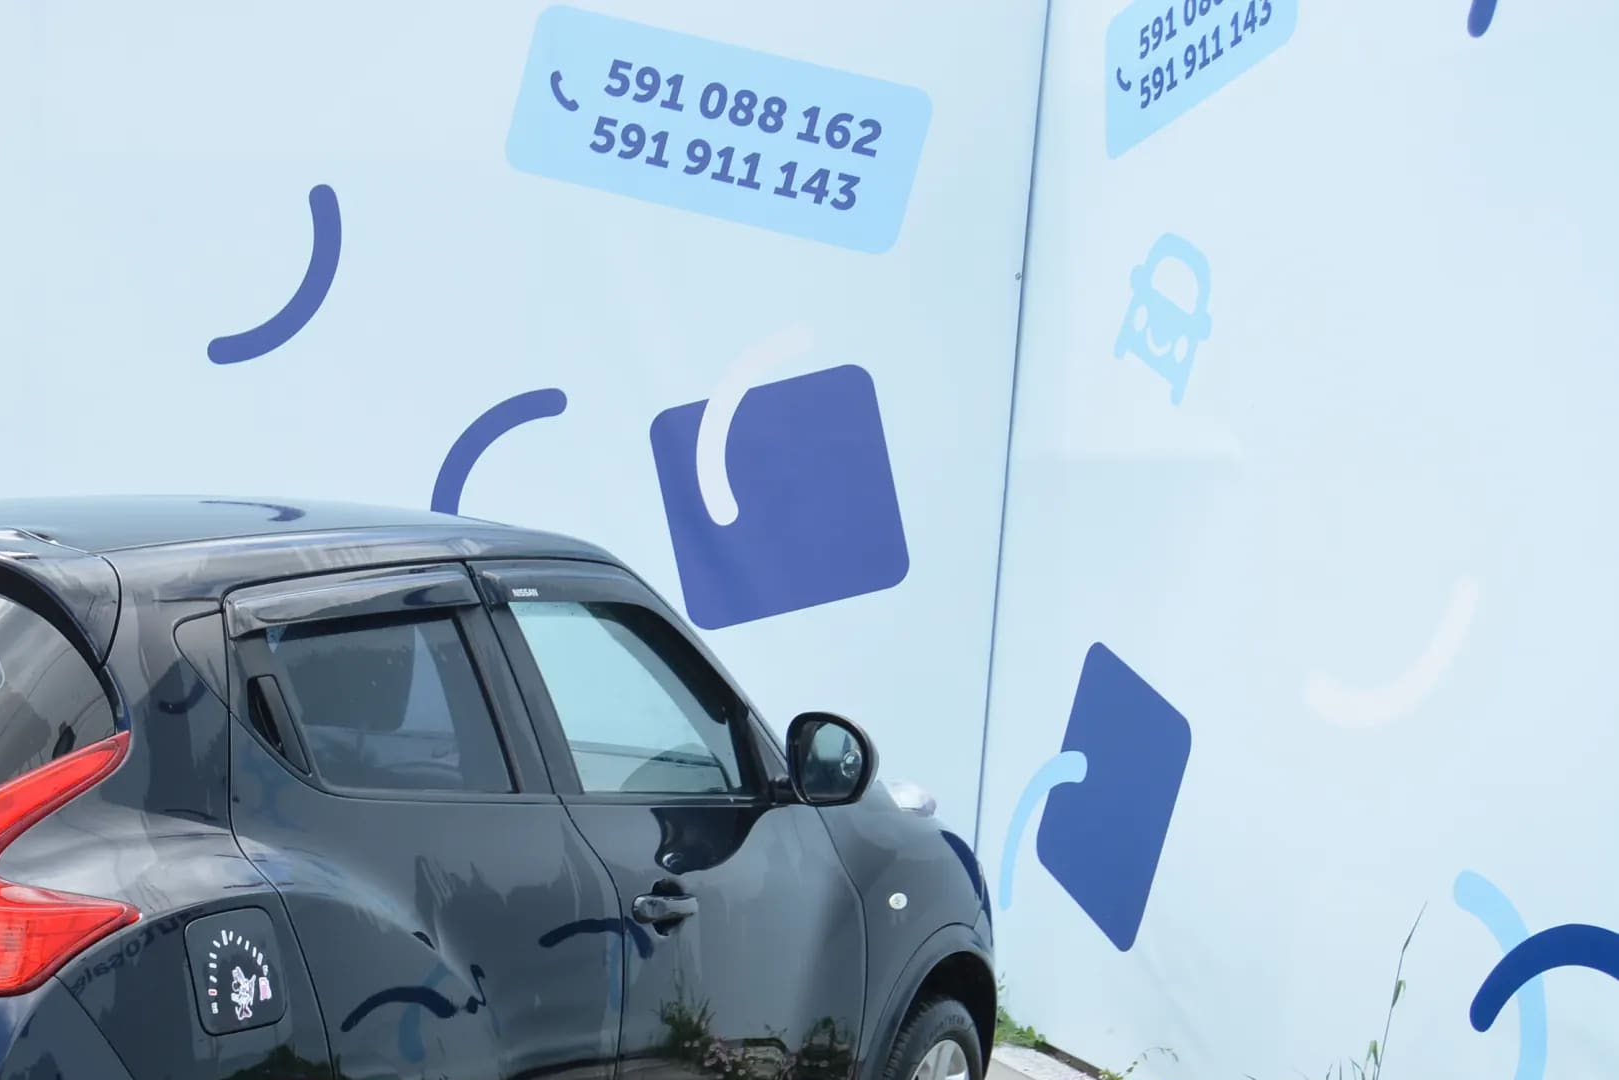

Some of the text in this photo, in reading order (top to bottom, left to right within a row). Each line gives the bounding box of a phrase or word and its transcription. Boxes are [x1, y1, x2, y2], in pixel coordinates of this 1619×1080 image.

[1139, 6, 1178, 60] 591
[1139, 0, 1272, 110] 591 911 143
[603, 58, 883, 158] 591 088 162
[589, 115, 862, 212] 591 911 143
